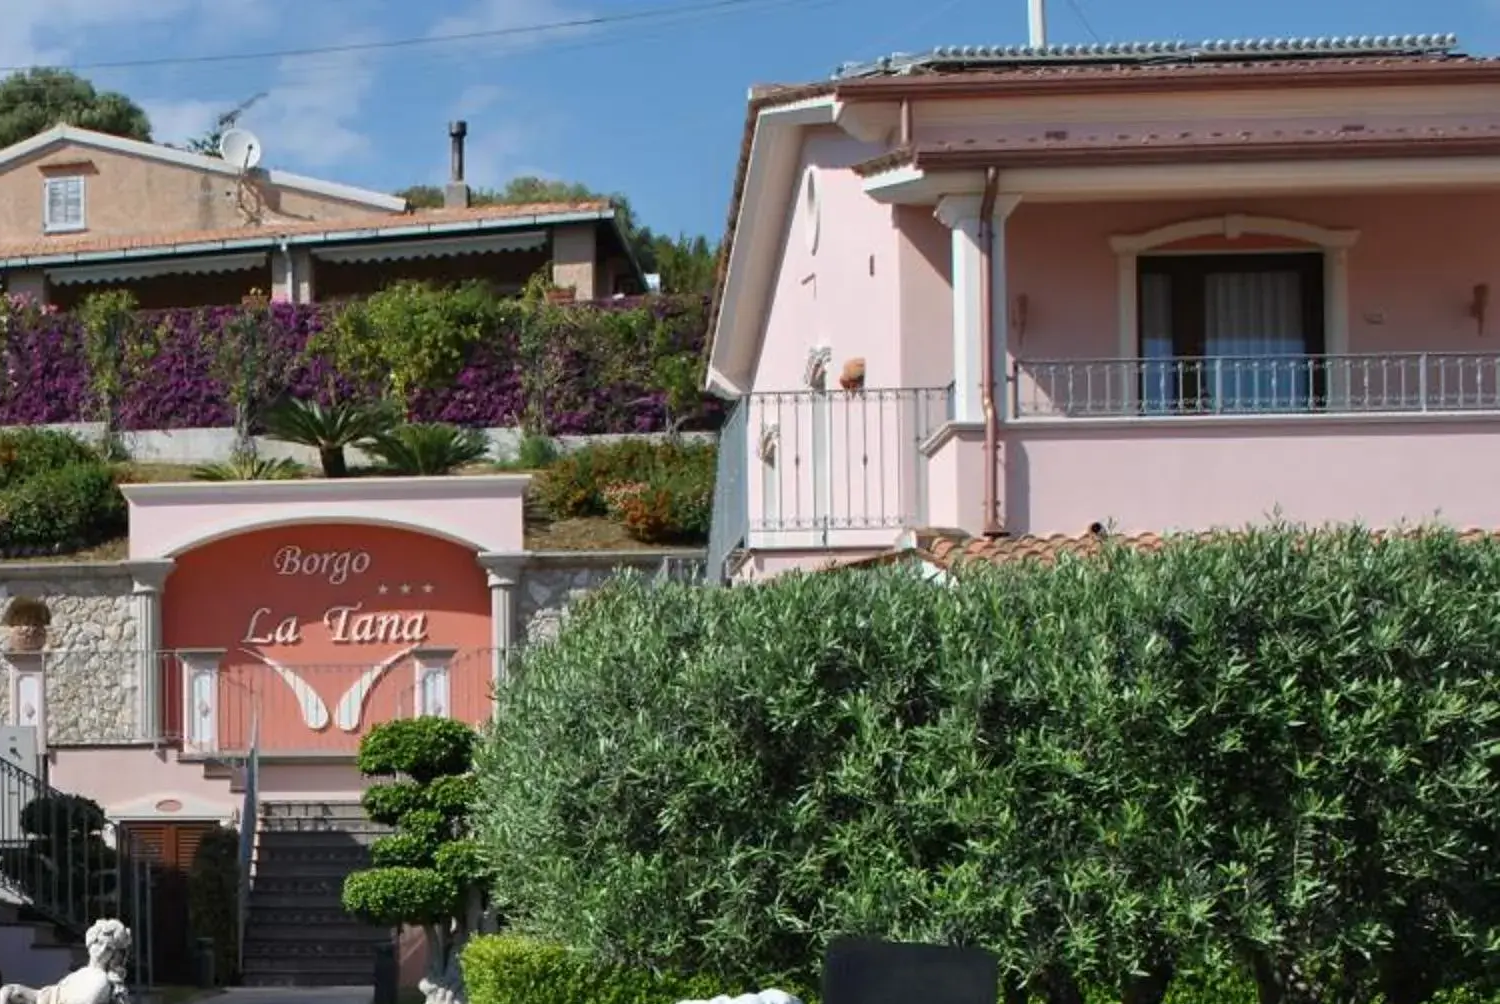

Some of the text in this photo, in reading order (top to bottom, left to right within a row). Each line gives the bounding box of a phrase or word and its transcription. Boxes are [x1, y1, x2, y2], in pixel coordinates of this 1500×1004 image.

[274, 544, 372, 585] Borgo
[242, 601, 430, 644] La Tana
